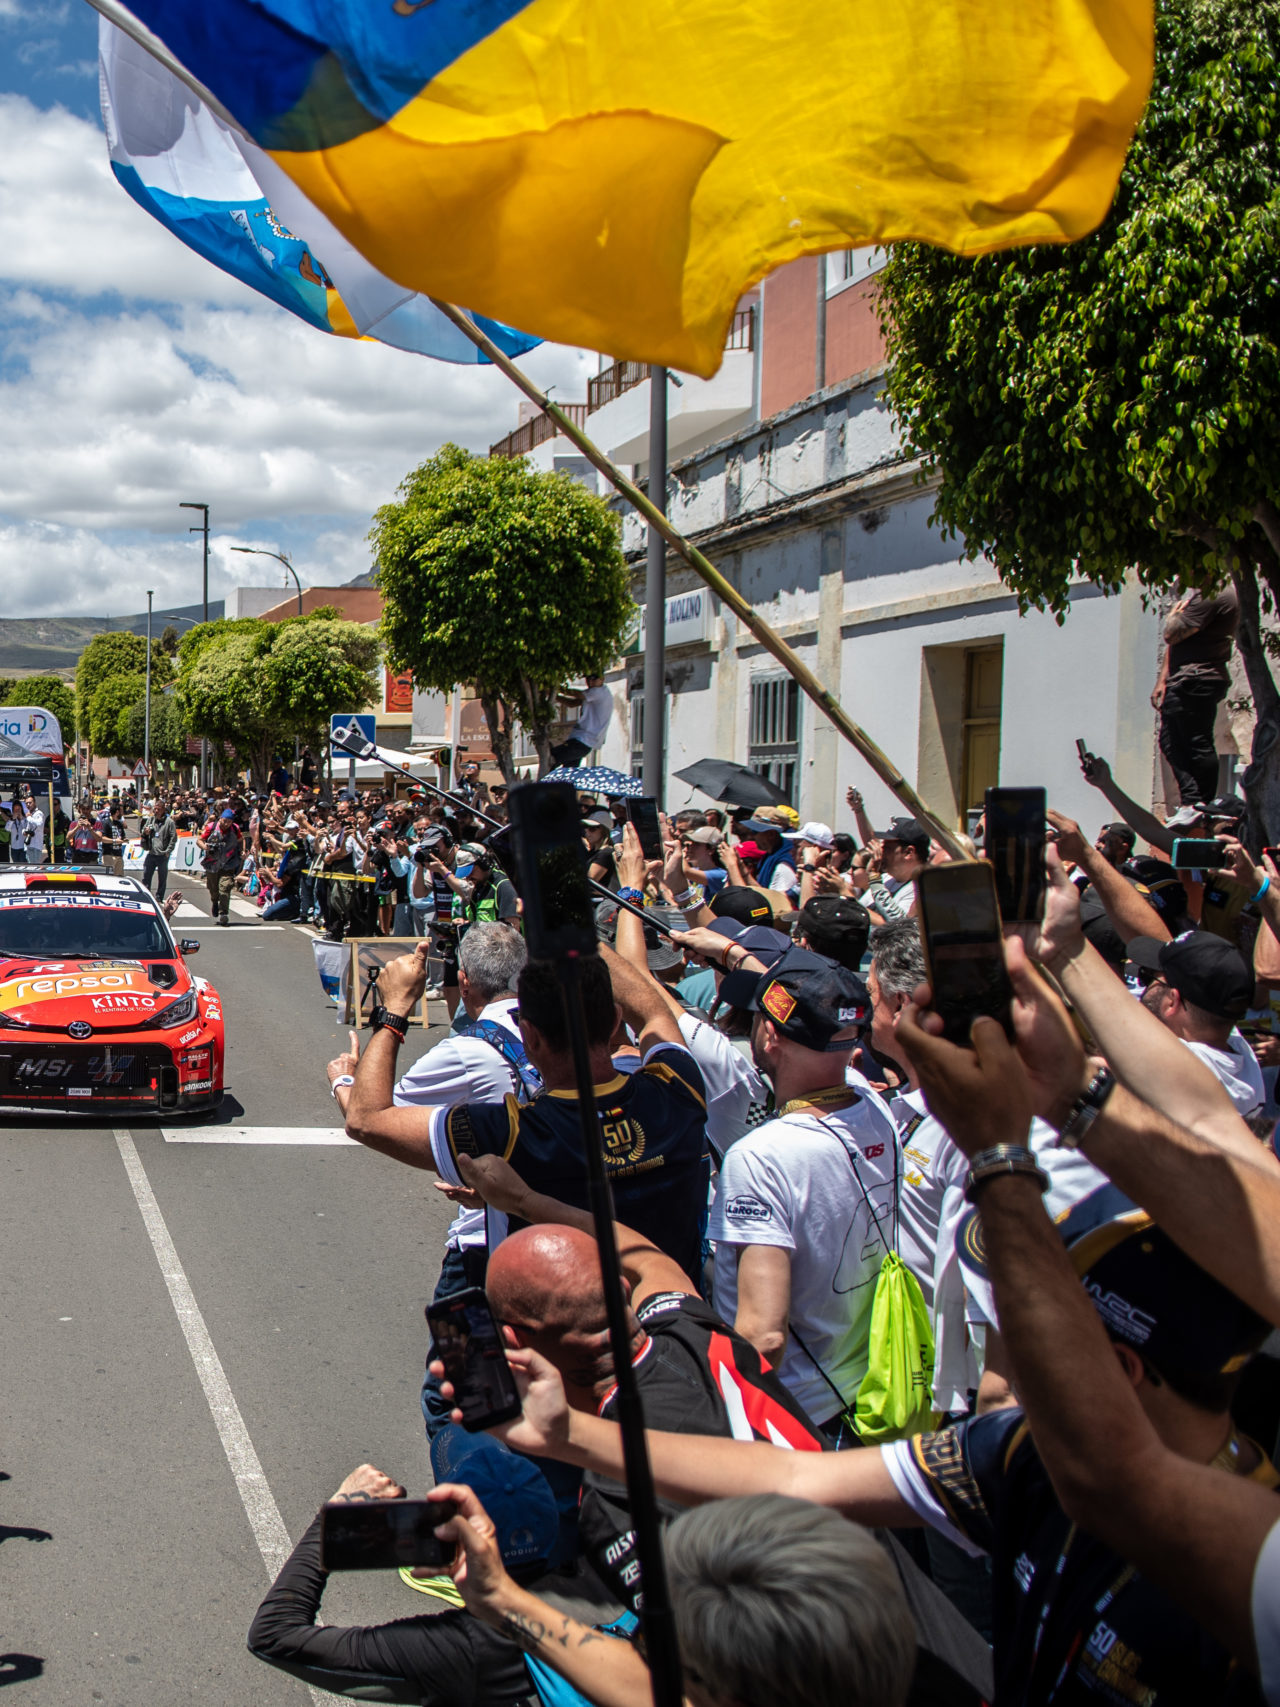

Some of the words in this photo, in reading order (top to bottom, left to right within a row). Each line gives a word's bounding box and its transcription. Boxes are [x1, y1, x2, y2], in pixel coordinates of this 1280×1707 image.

[669, 594, 702, 624] MOLINO
[9, 897, 141, 910] FORUM8
[90, 891, 130, 899] Racing
[17, 973, 133, 998] repsol
[603, 1120, 632, 1148] 50
[728, 1204, 768, 1217] LaRoca
[1089, 1619, 1118, 1655] 50
